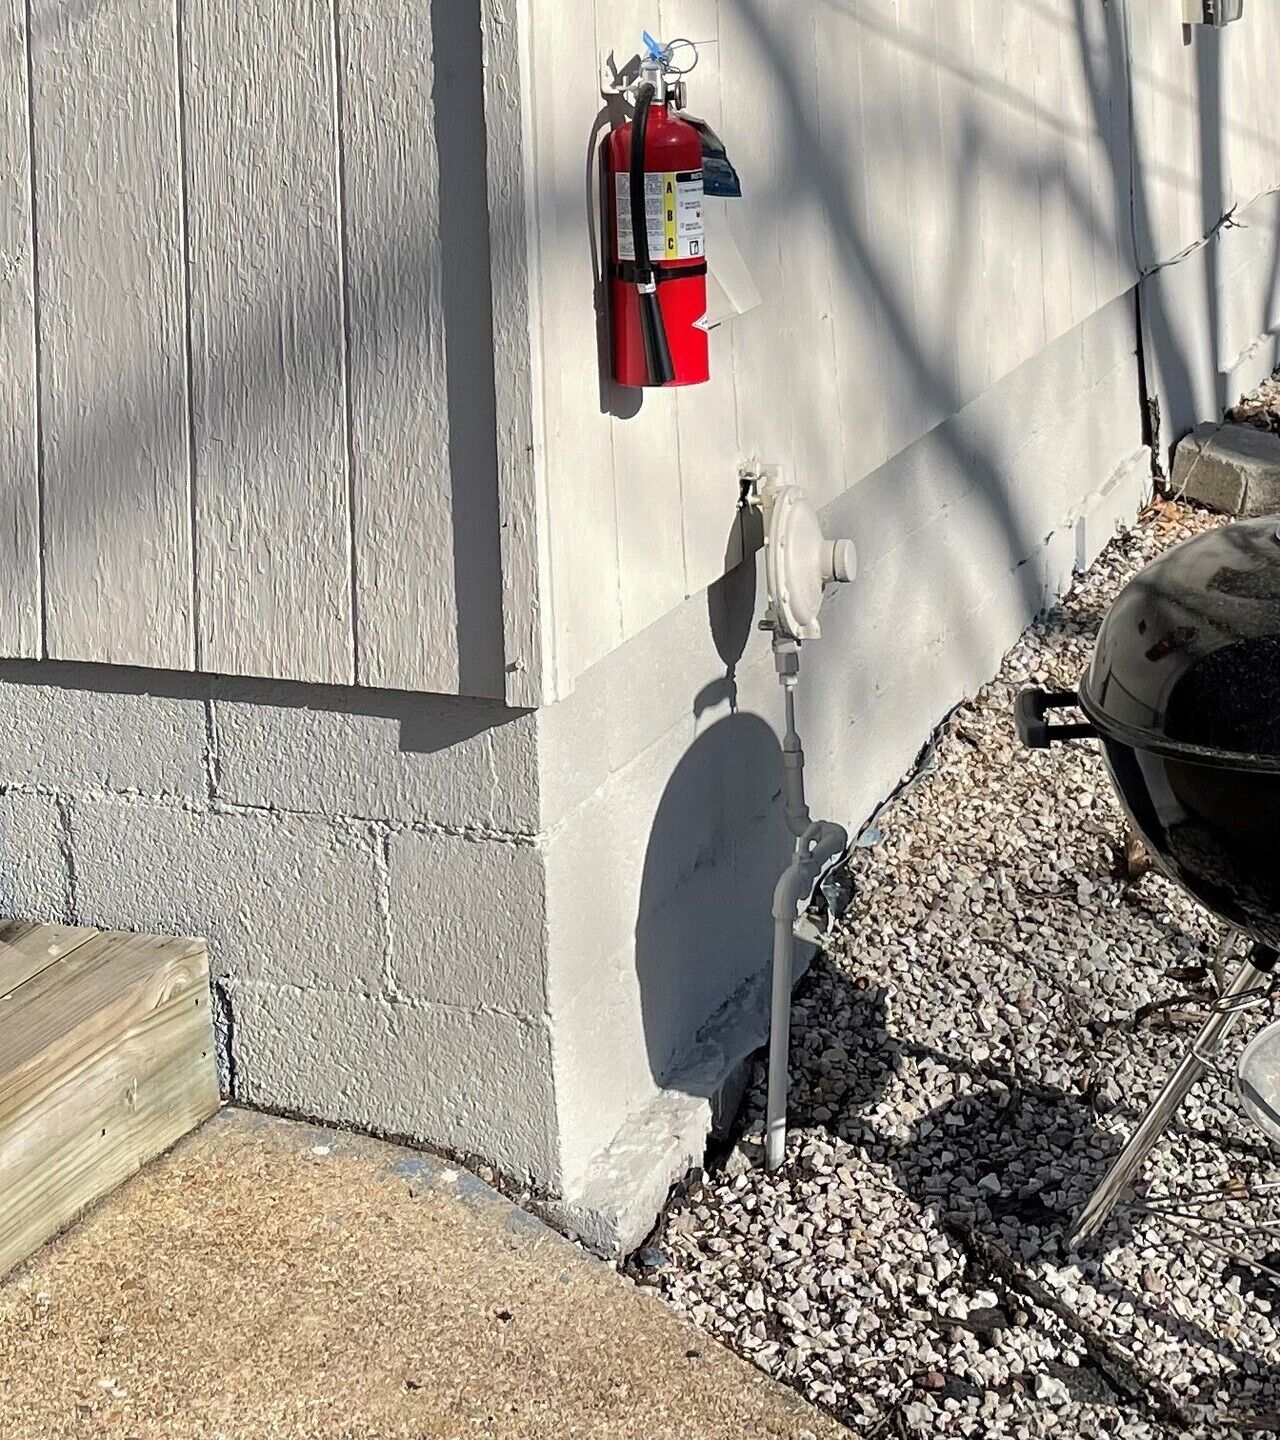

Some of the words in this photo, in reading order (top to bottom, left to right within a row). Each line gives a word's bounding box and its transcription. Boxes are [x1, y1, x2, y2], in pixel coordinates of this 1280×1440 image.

[666, 181, 673, 194] A
[667, 209, 673, 222] B
[668, 237, 674, 250] C
